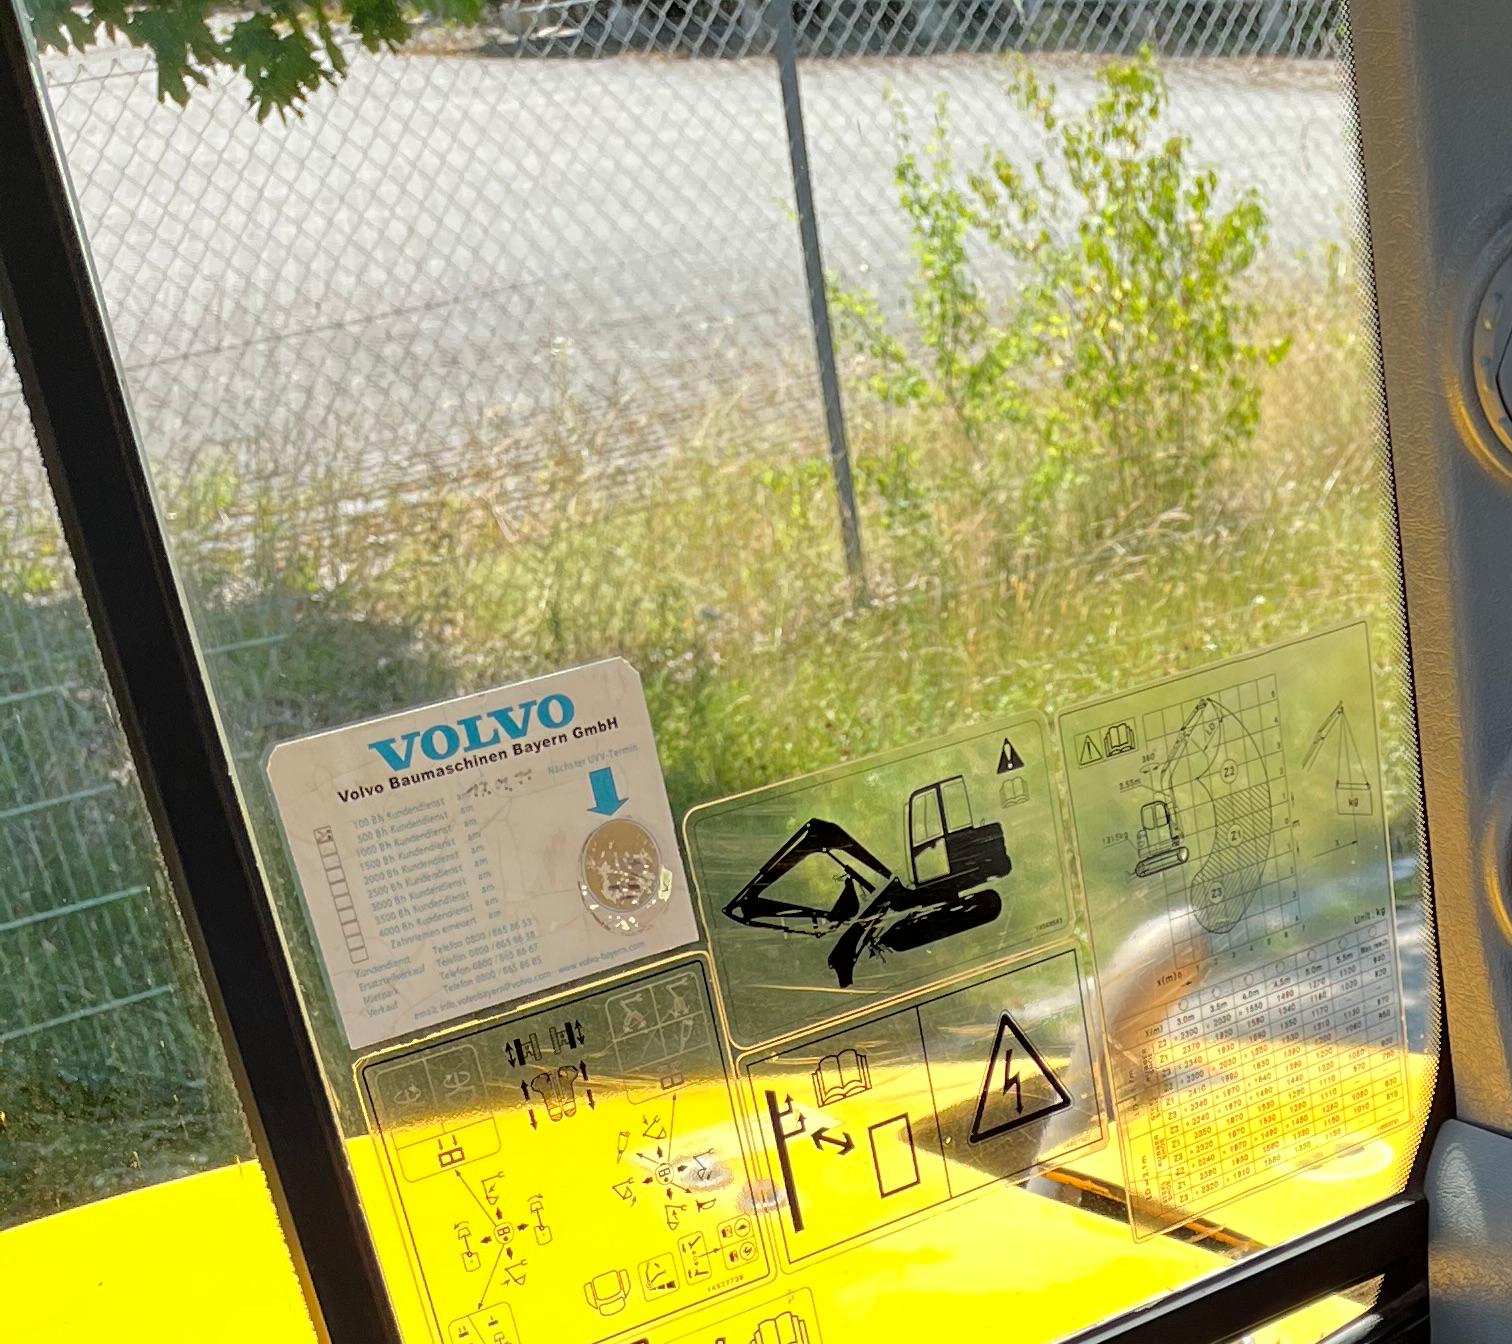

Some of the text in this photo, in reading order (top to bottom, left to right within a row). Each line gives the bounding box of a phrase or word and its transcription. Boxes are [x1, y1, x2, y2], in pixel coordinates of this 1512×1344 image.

[368, 693, 575, 772] VOLVO
[336, 780, 384, 804] Volvo
[388, 748, 507, 789] Baumaschinen
[511, 730, 568, 759] Bayern
[571, 716, 618, 740] GmbH
[1224, 765, 1235, 778] Z2
[1231, 830, 1241, 841] Z1
[1211, 887, 1222, 899] Z3
